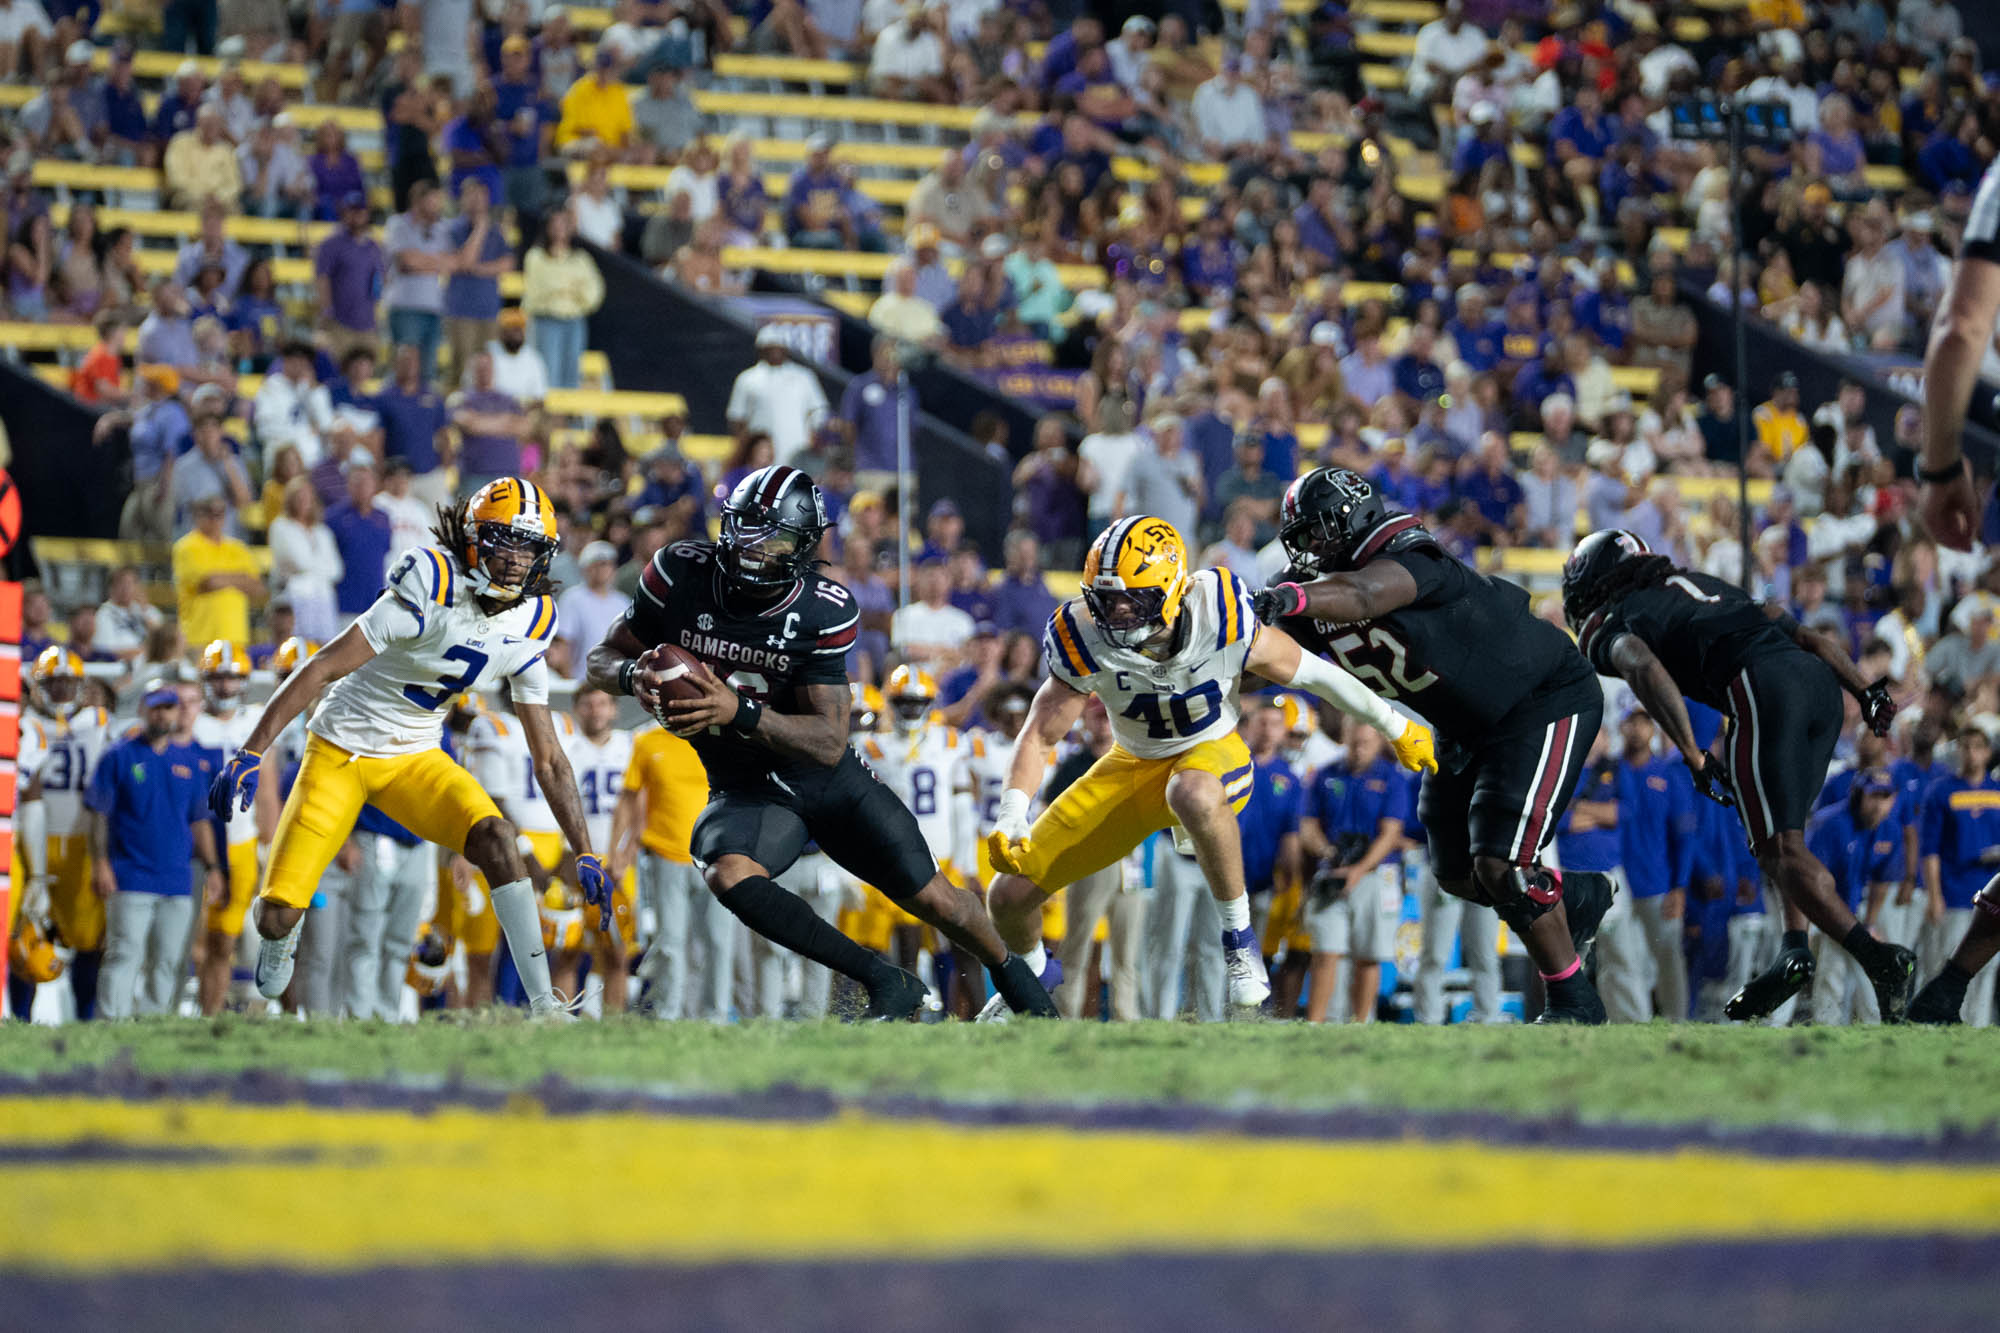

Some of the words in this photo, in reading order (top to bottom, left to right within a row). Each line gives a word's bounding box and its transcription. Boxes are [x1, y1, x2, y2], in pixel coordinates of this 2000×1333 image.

[814, 581, 849, 608] 16
[697, 613, 714, 631] SEC
[783, 612, 800, 639] C
[466, 637, 486, 648] LSU
[680, 629, 791, 672] GAMECOCKS
[1329, 627, 1440, 698] 52
[1116, 671, 1131, 691] C
[1120, 679, 1223, 739] 40
[43, 746, 87, 792] 31
[912, 767, 936, 815] 8
